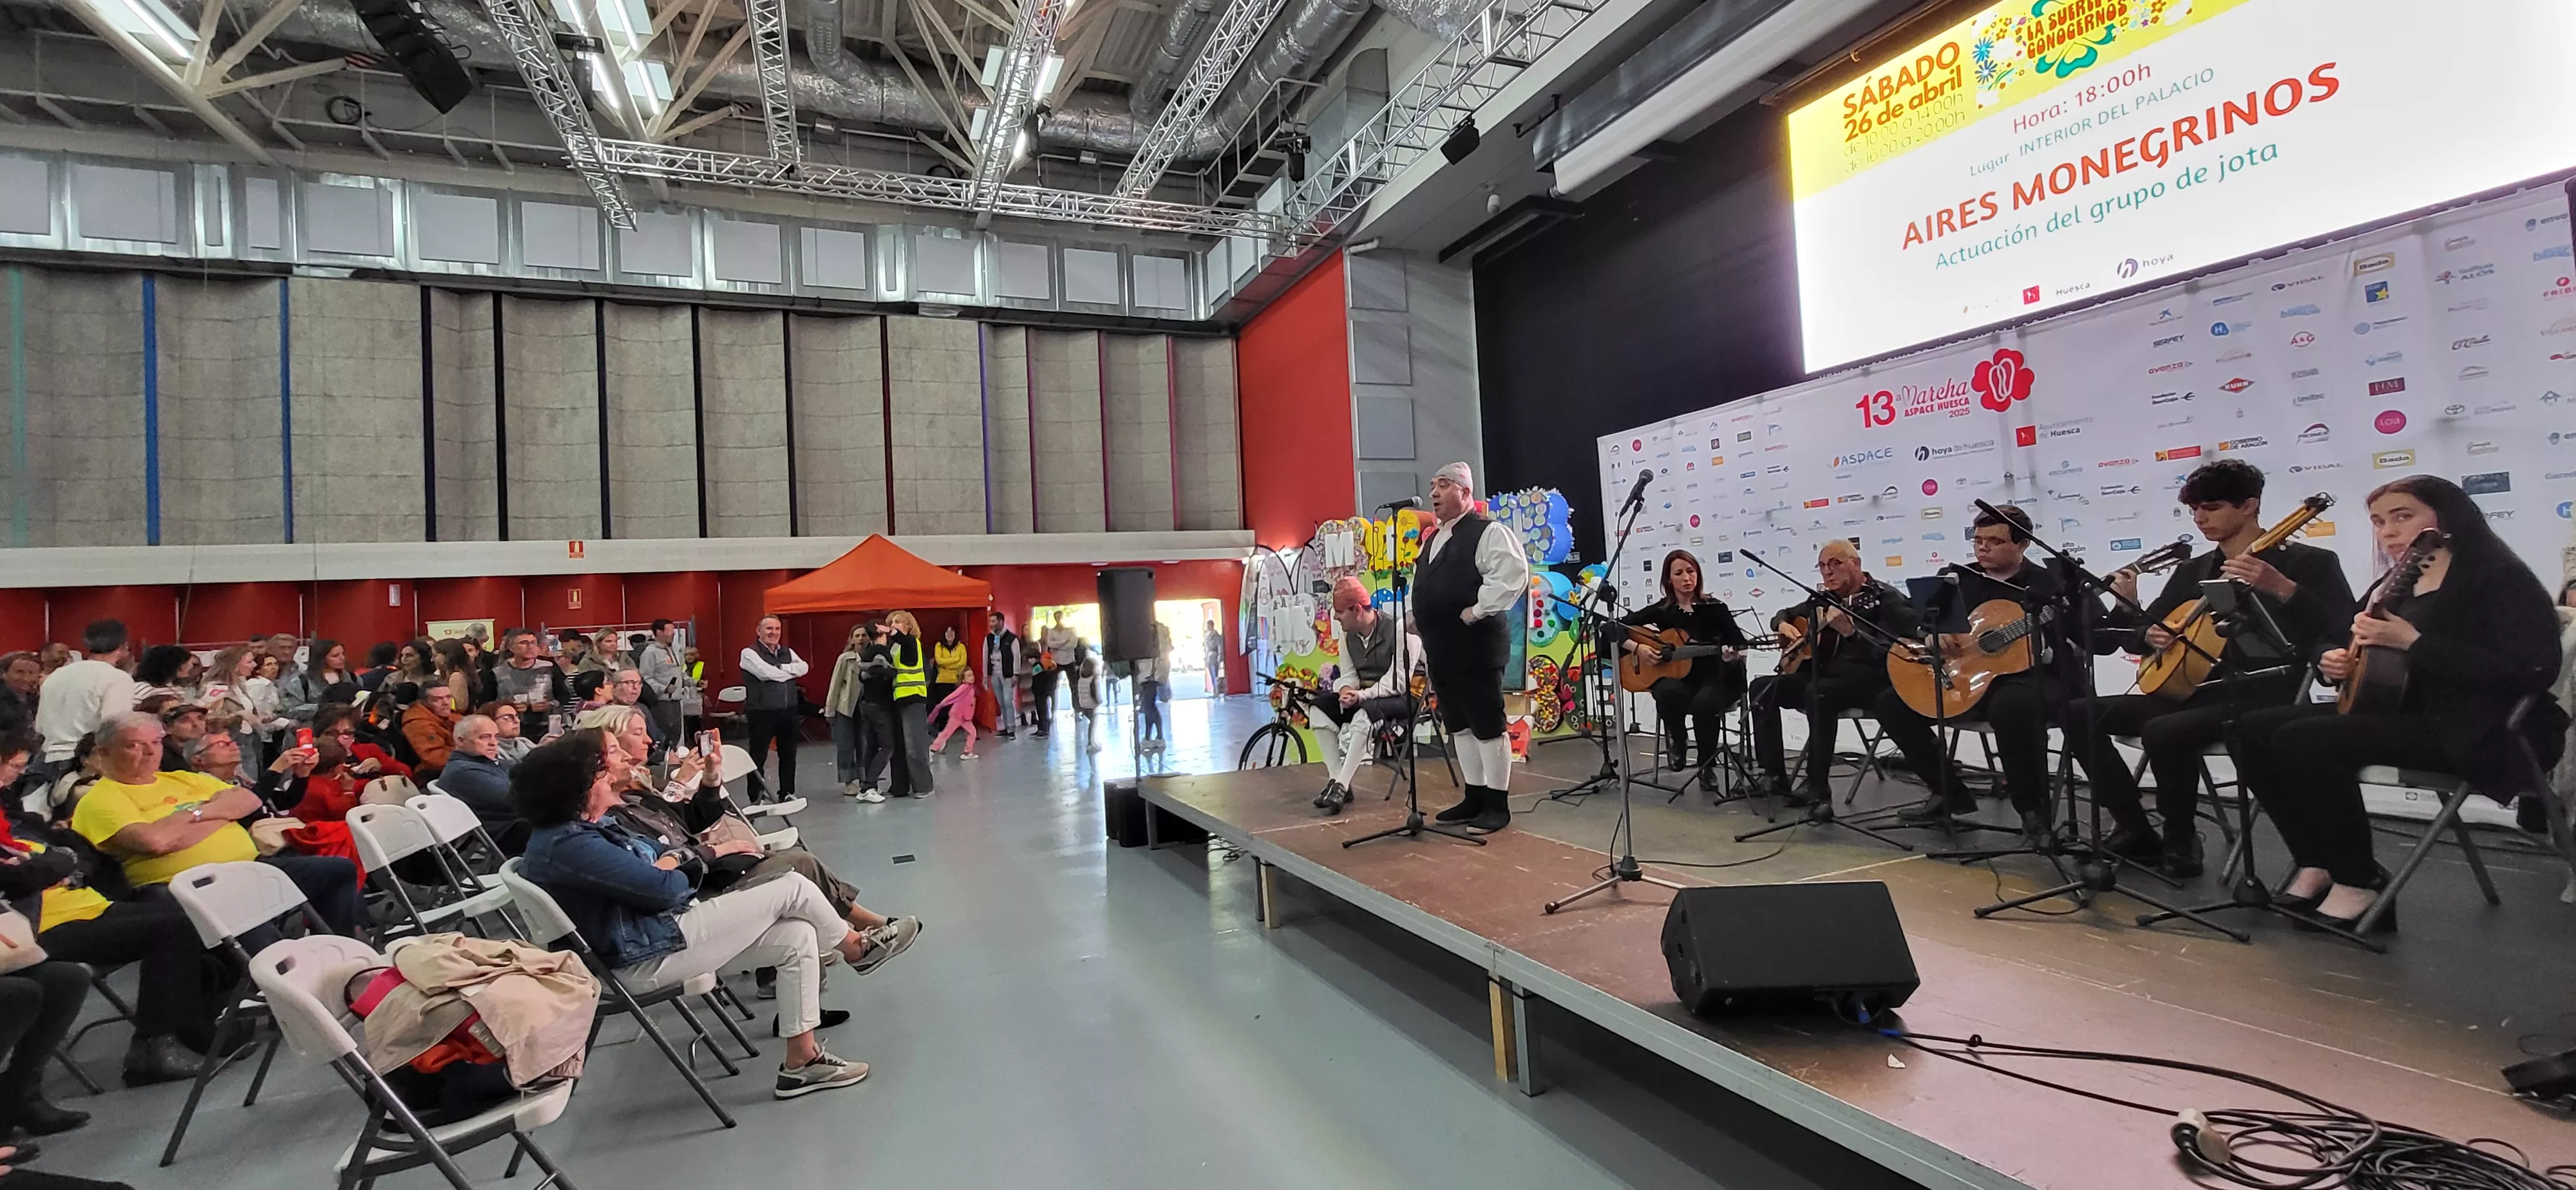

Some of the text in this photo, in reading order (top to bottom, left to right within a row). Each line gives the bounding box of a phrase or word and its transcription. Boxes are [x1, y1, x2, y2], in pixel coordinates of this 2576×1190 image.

[2027, 19, 2044, 41] LA
[1843, 42, 1960, 118] SÁBADO
[1844, 64, 1962, 142] 26 de abril
[2013, 64, 2152, 134] Hora: 18:00h
[2020, 117, 2092, 156] INTERIOR
[2098, 104, 2130, 126] DEL
[2136, 68, 2215, 110] PALACIO
[1902, 62, 2340, 250] AIRES MONEGRINOS
[1935, 141, 2279, 270] Actuación del grupo de jota
[2143, 254, 2174, 268] hoya
[2056, 281, 2090, 296] Huesca
[2148, 361, 2184, 375] avanza
[1901, 377, 1969, 407] Marcha
[2224, 381, 2249, 390] KUHN
[1904, 397, 1971, 418] ASPACE HUESCA
[1949, 407, 1971, 419] 2025
[2050, 426, 2081, 439] Huesca
[1931, 446, 1953, 457] hoya
[1963, 439, 1994, 450] huesca
[2304, 463, 2343, 471] VIDAL
[2063, 545, 2086, 554] ragón
